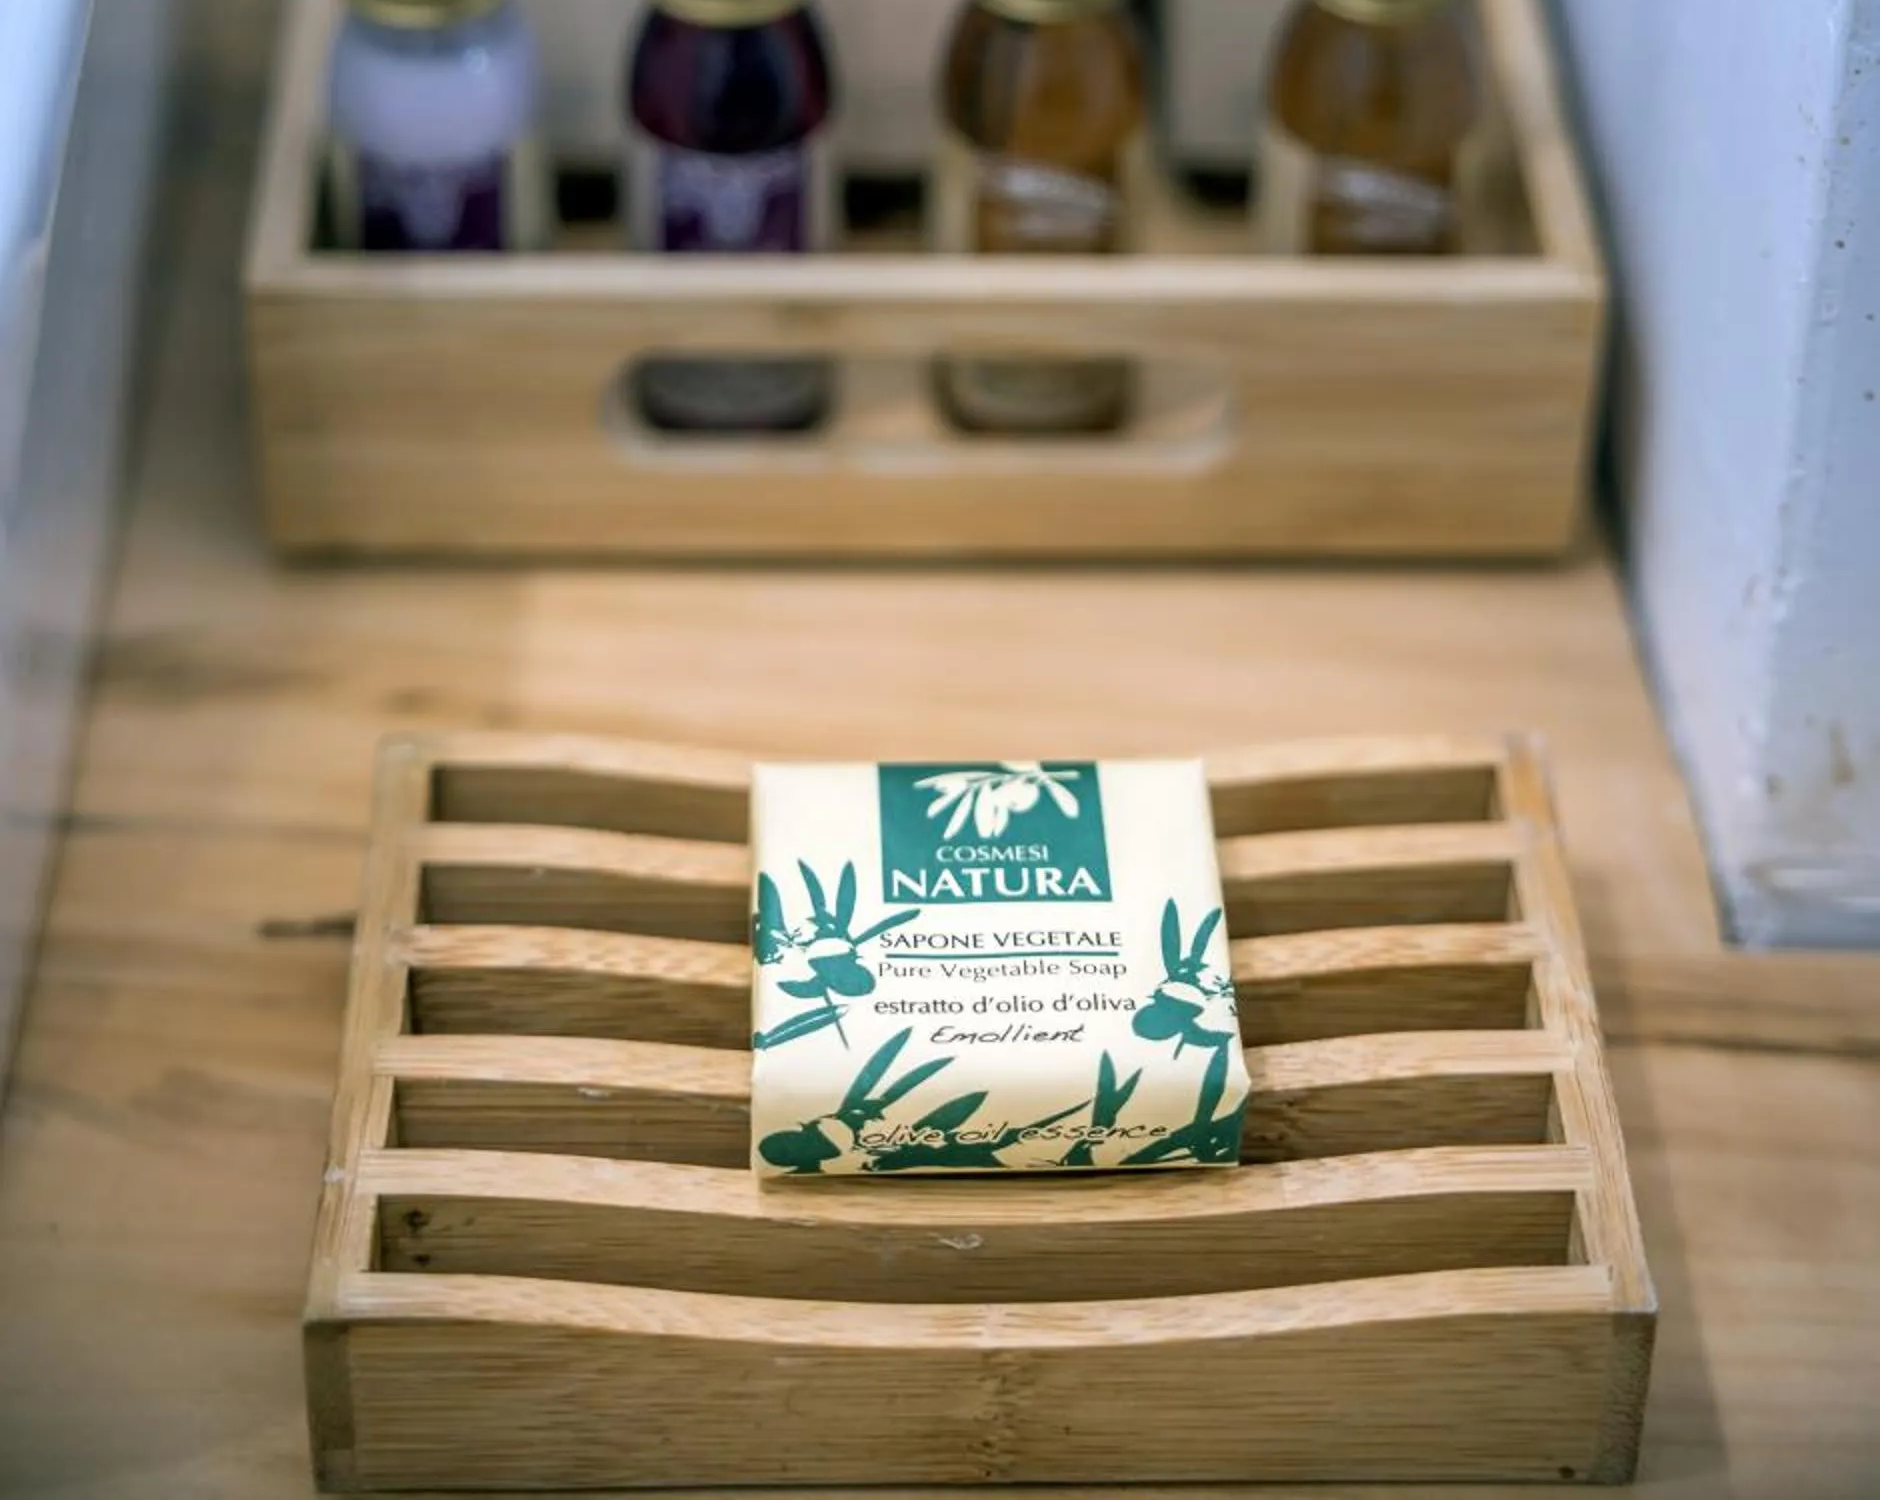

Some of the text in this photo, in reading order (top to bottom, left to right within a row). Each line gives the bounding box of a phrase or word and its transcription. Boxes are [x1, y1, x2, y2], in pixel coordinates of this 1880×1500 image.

[936, 845, 1050, 863] COSMESI
[892, 867, 1101, 898] NATURA
[879, 930, 1123, 949] SAPONE VEGETALE
[878, 959, 1128, 984] Pure Vegetable Soap
[873, 992, 1136, 1014] estratto d'olio d'oliva
[929, 1023, 1087, 1044] Emollient
[861, 1120, 1170, 1146] olive oil essence
